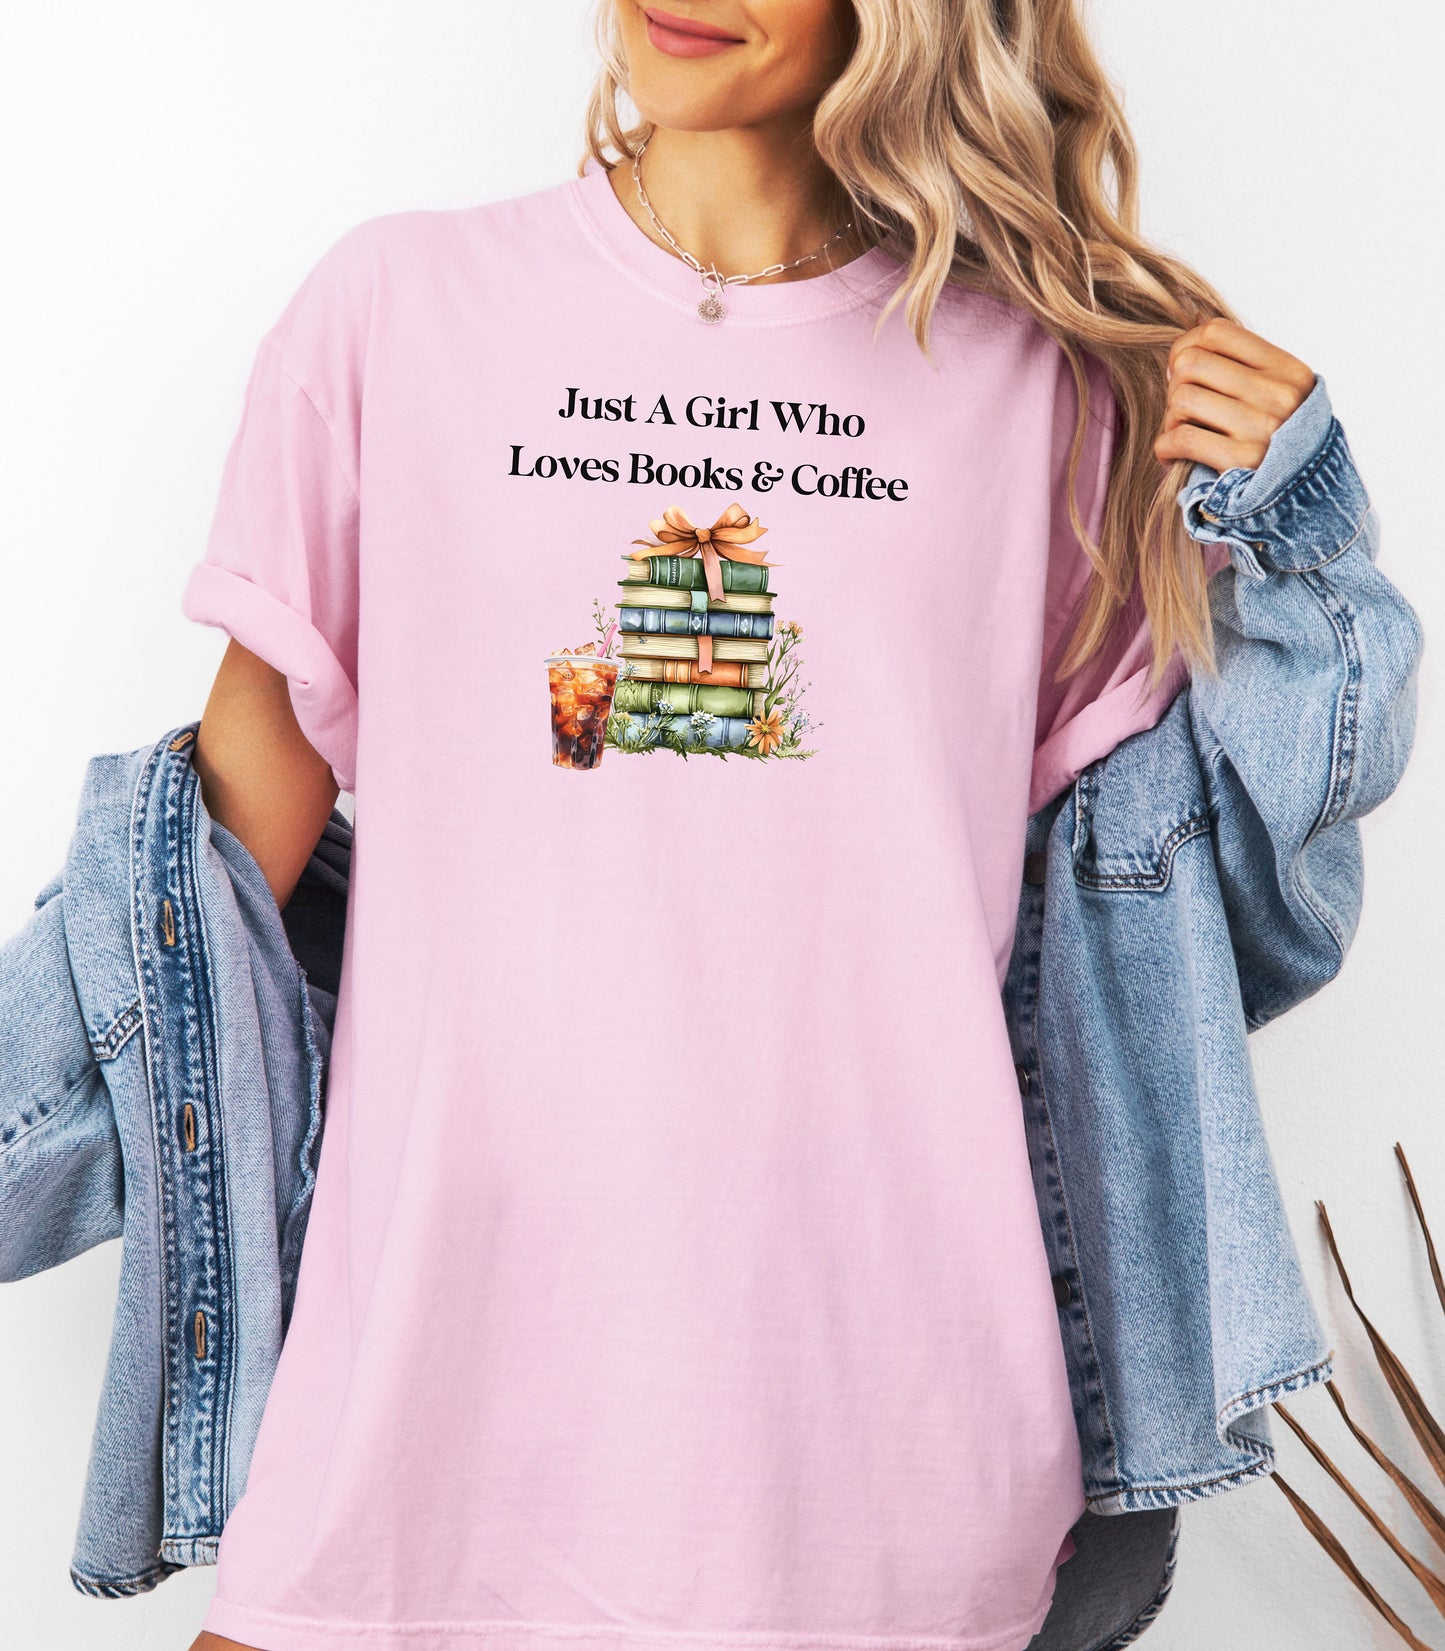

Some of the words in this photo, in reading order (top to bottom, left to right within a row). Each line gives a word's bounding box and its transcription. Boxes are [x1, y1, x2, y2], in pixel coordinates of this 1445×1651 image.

[558, 387, 637, 423] Just
[644, 393, 677, 426] A
[685, 395, 760, 431] Girl
[769, 400, 866, 438] Who
[507, 444, 620, 483] Loves
[627, 452, 743, 491] Books
[751, 461, 784, 493] &
[791, 464, 909, 502] Coffee
